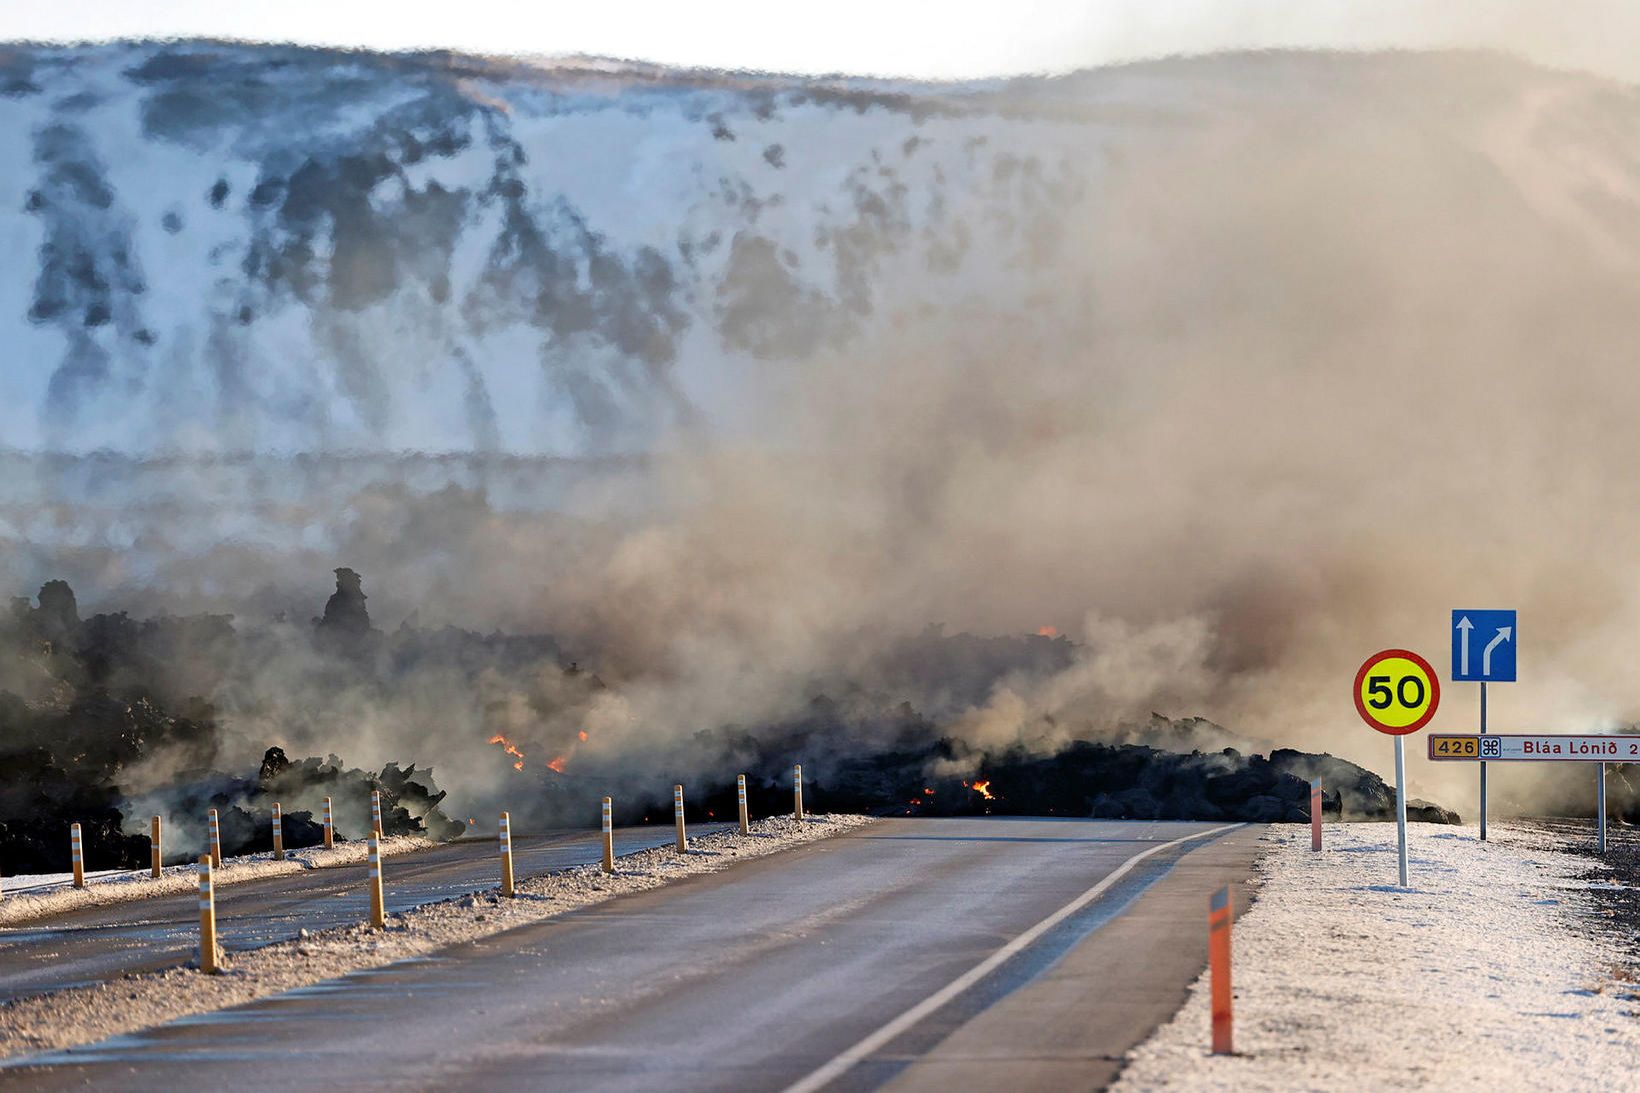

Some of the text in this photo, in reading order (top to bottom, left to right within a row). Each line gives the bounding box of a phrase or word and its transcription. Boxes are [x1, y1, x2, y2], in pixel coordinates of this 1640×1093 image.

[1368, 675, 1425, 710] 50
[1438, 741, 1474, 754] 426
[1523, 741, 1638, 755] Bláa Lónið 2
